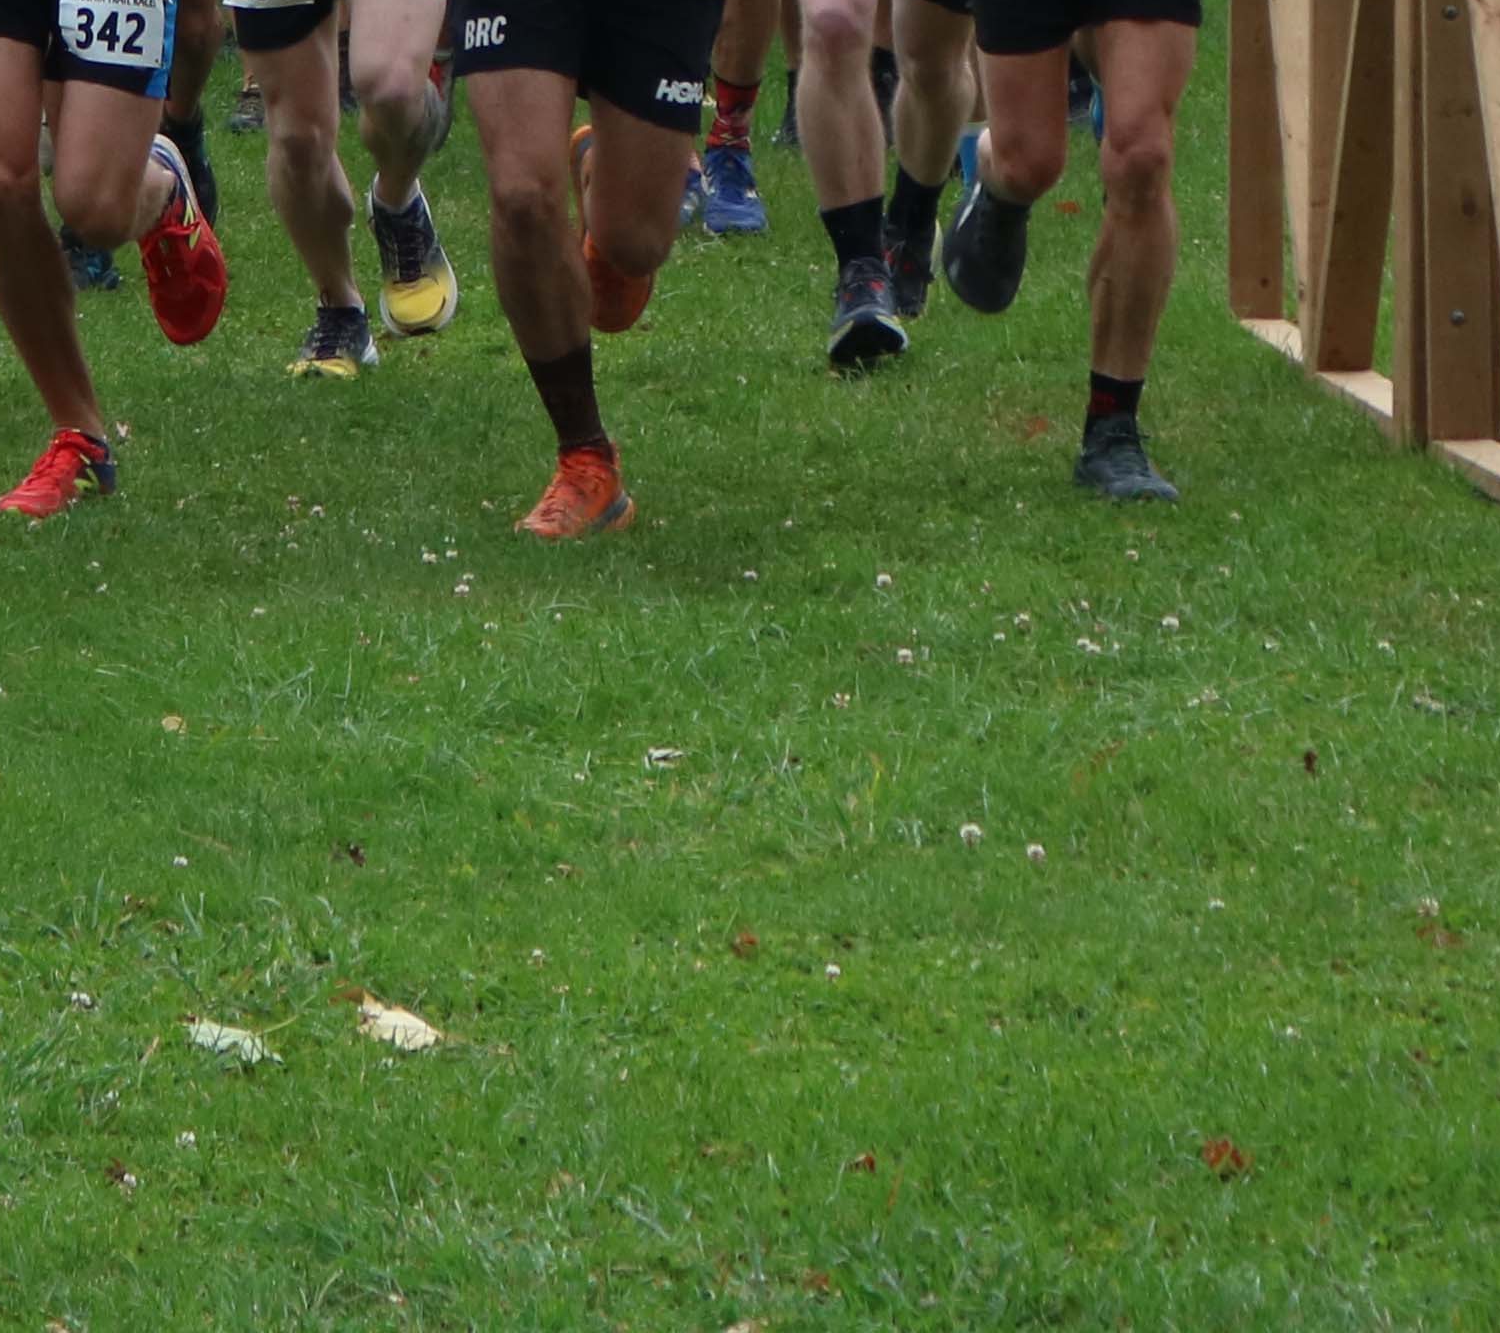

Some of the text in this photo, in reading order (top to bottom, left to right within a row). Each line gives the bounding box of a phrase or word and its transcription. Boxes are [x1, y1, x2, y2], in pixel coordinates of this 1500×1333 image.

[74, 6, 147, 56] 342
[464, 15, 508, 51] BRC
[655, 78, 703, 104] HOK
